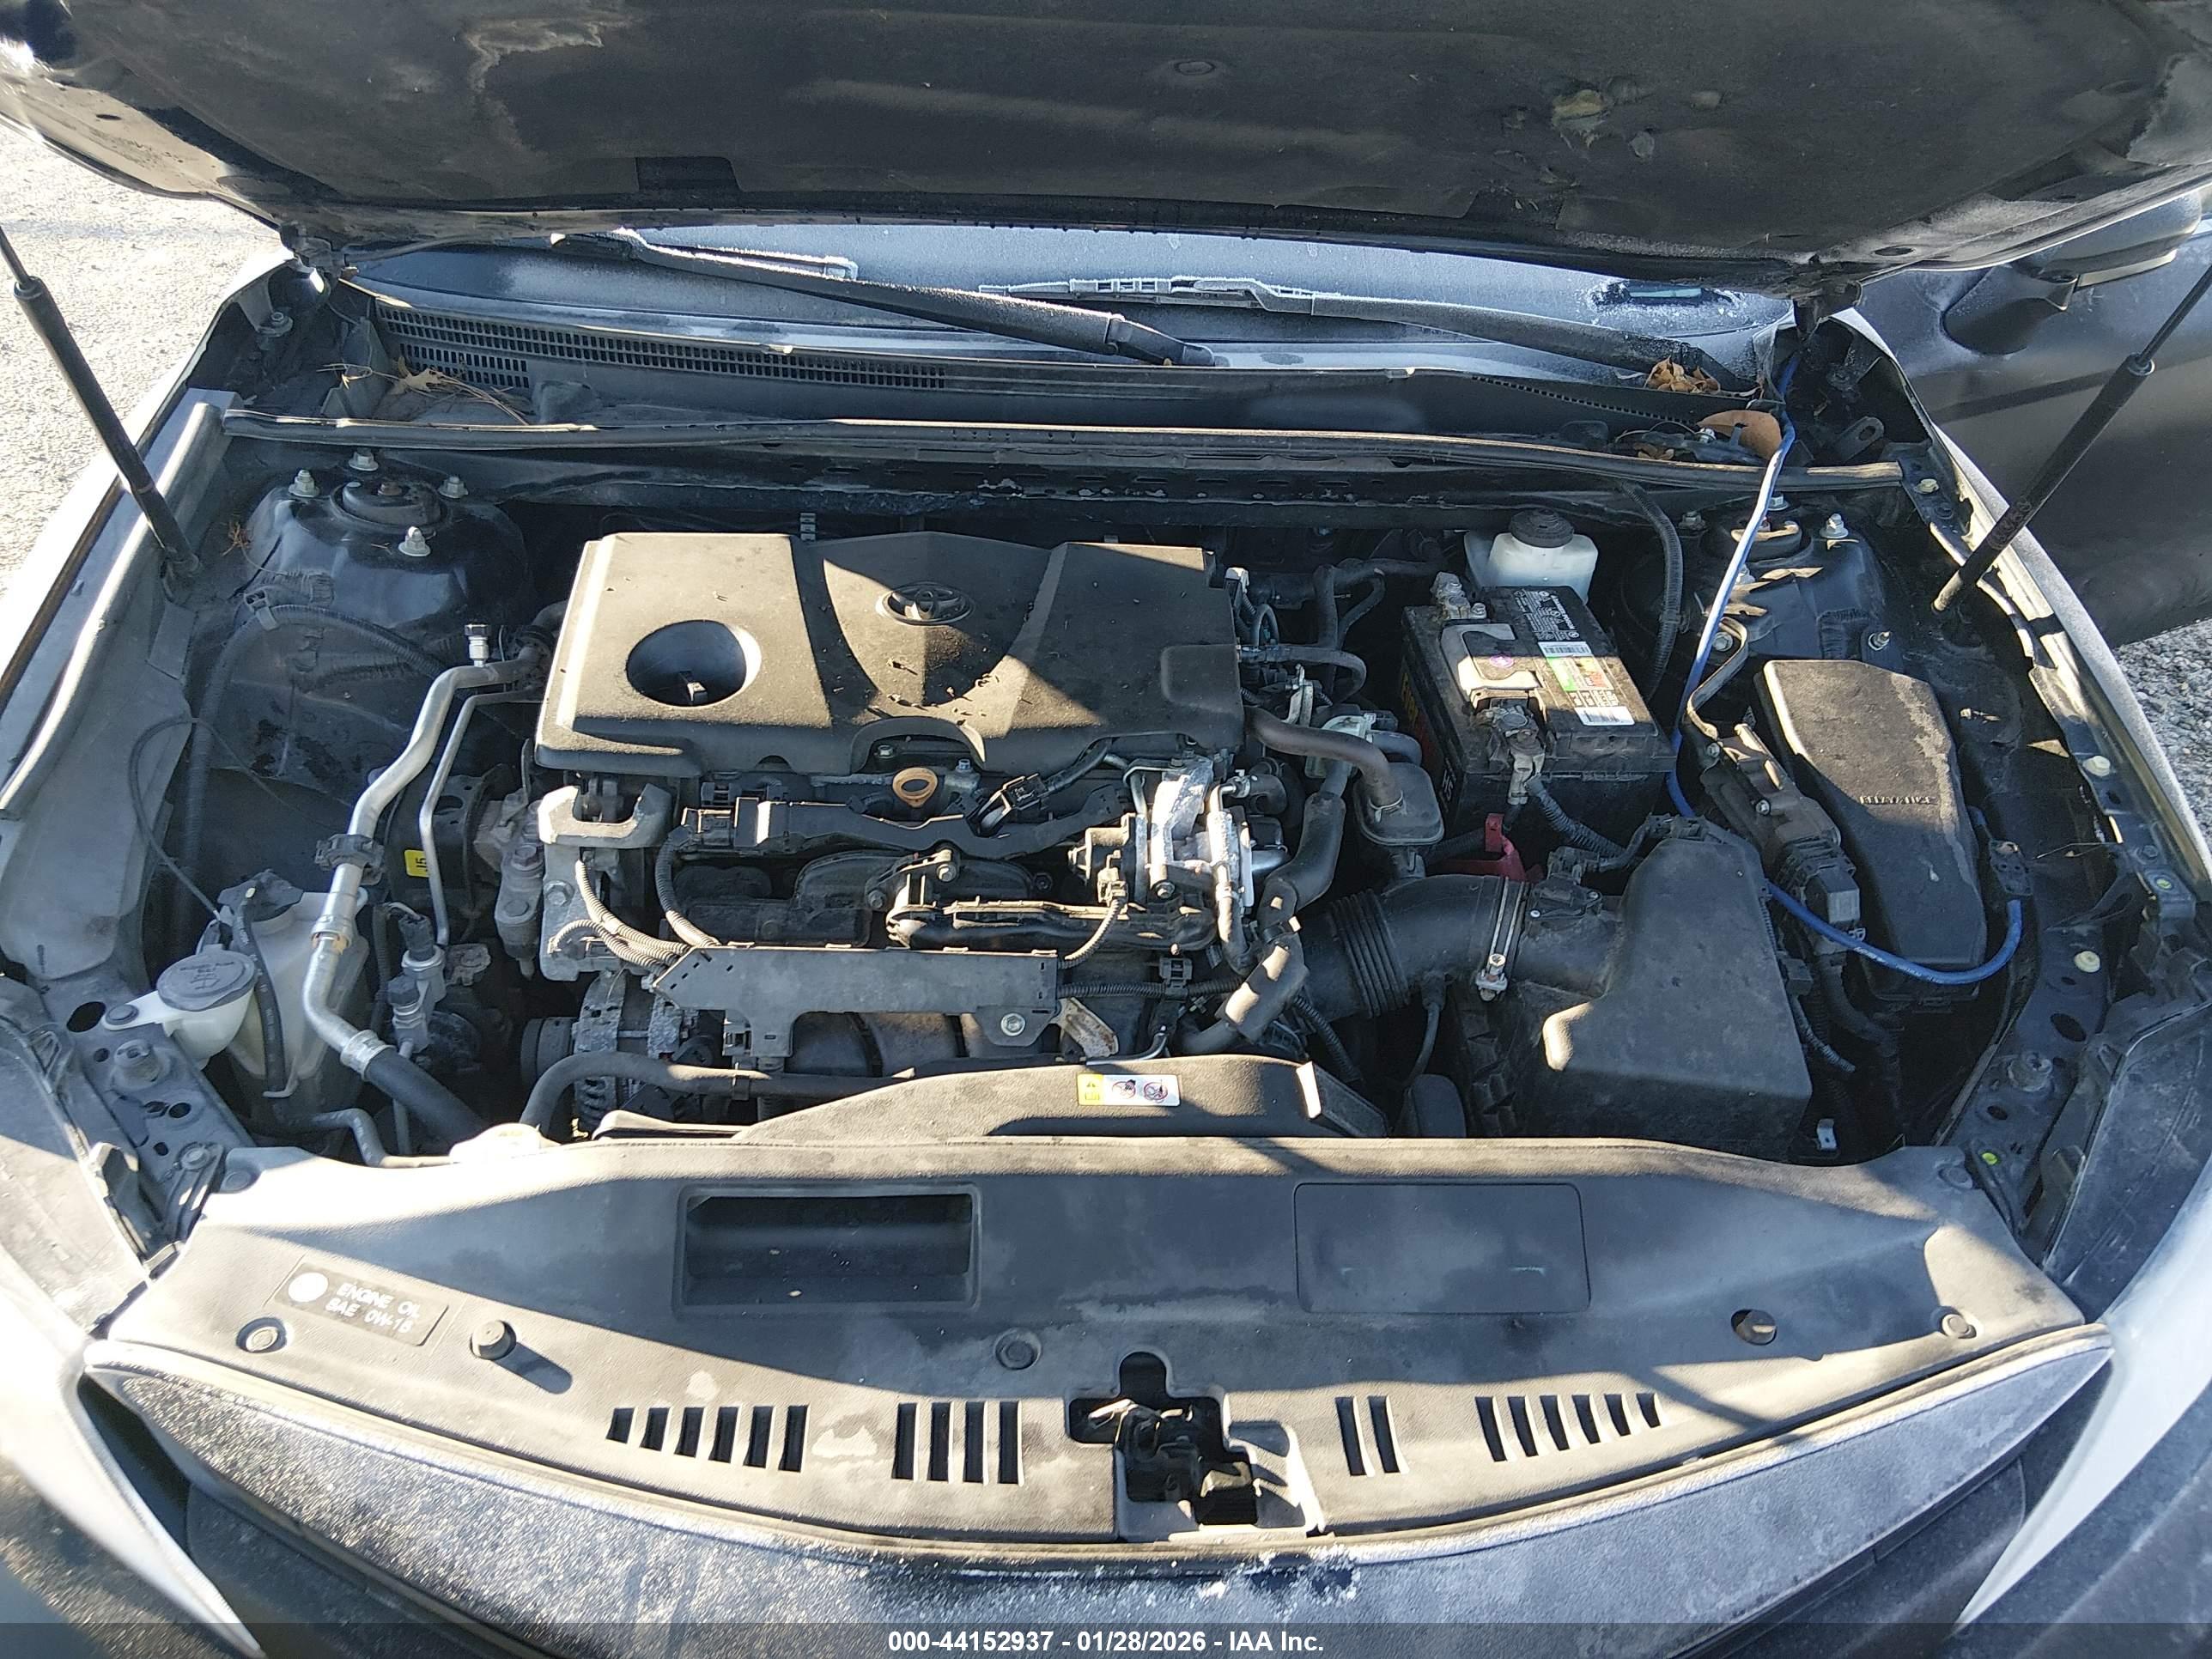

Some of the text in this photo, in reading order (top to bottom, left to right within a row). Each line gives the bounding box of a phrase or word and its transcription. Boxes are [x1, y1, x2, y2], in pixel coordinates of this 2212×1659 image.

[325, 1297, 361, 1317] SAE
[337, 1283, 421, 1320] ENGINE OIL
